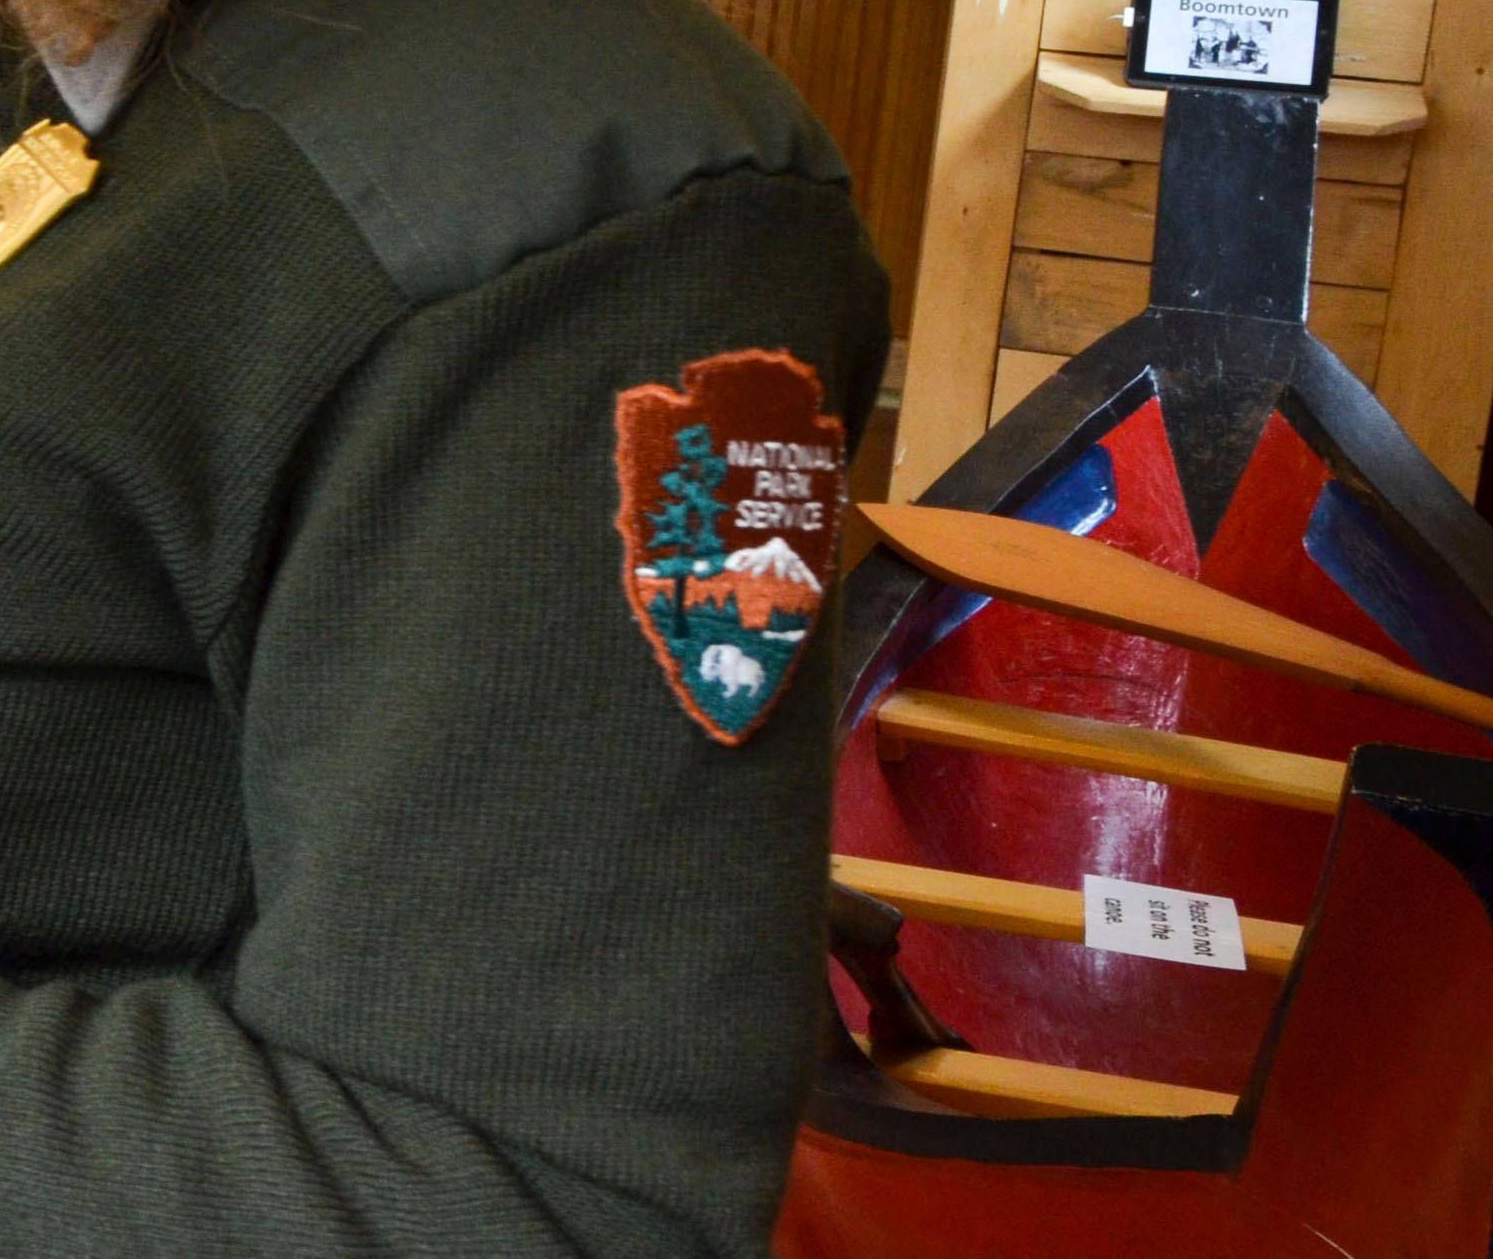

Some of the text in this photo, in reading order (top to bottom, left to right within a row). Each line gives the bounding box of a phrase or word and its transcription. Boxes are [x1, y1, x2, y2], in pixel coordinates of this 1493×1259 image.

[727, 441, 835, 470] NATIONAL
[754, 470, 811, 498] PARK
[735, 500, 823, 530] SERVICE
[1104, 897, 1123, 925] canoe.
[1148, 899, 1175, 940] sit on the
[1188, 899, 1216, 957] Please do not
